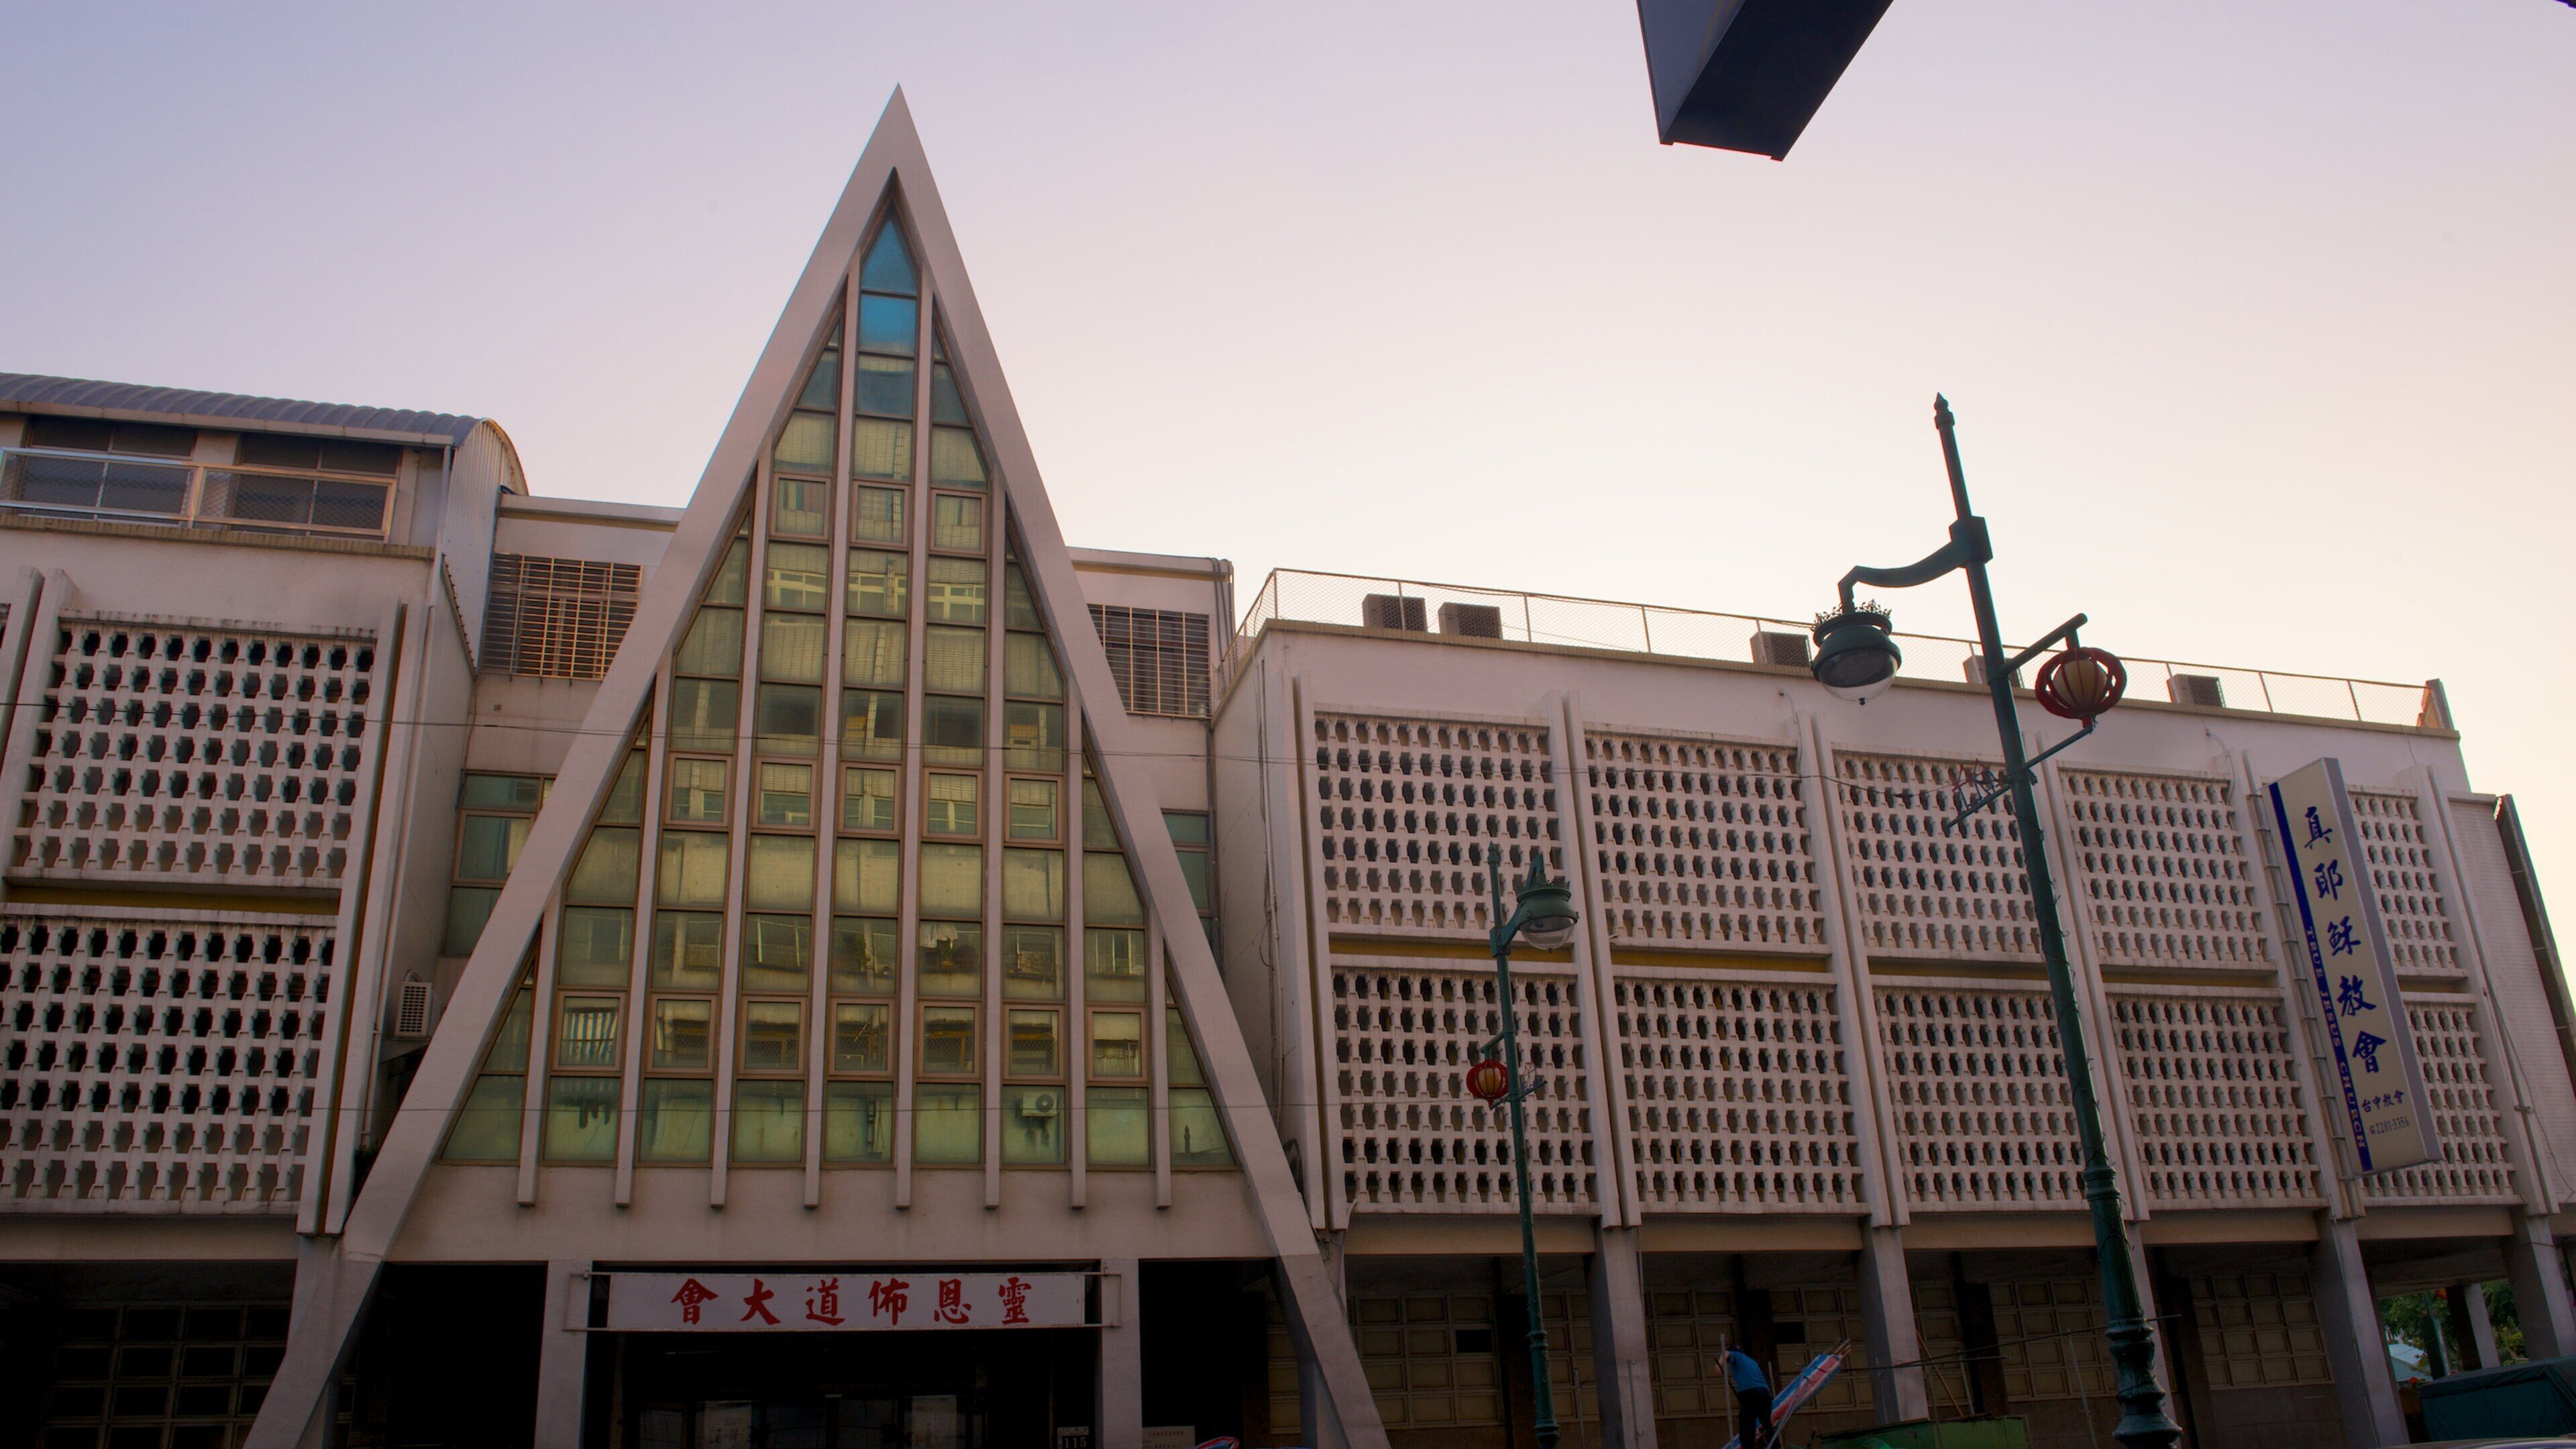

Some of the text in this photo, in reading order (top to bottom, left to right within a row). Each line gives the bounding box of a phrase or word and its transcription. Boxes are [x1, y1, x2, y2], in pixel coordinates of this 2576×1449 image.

[2304, 805, 2386, 1074] 真耶穌教會
[2307, 926, 2367, 1149] TRUE JESUS CHURCH
[2361, 1089, 2404, 1113] 台中教會
[670, 1277, 1034, 1326] 靈恩佈道大會
[1064, 1436, 1087, 1449] 115
